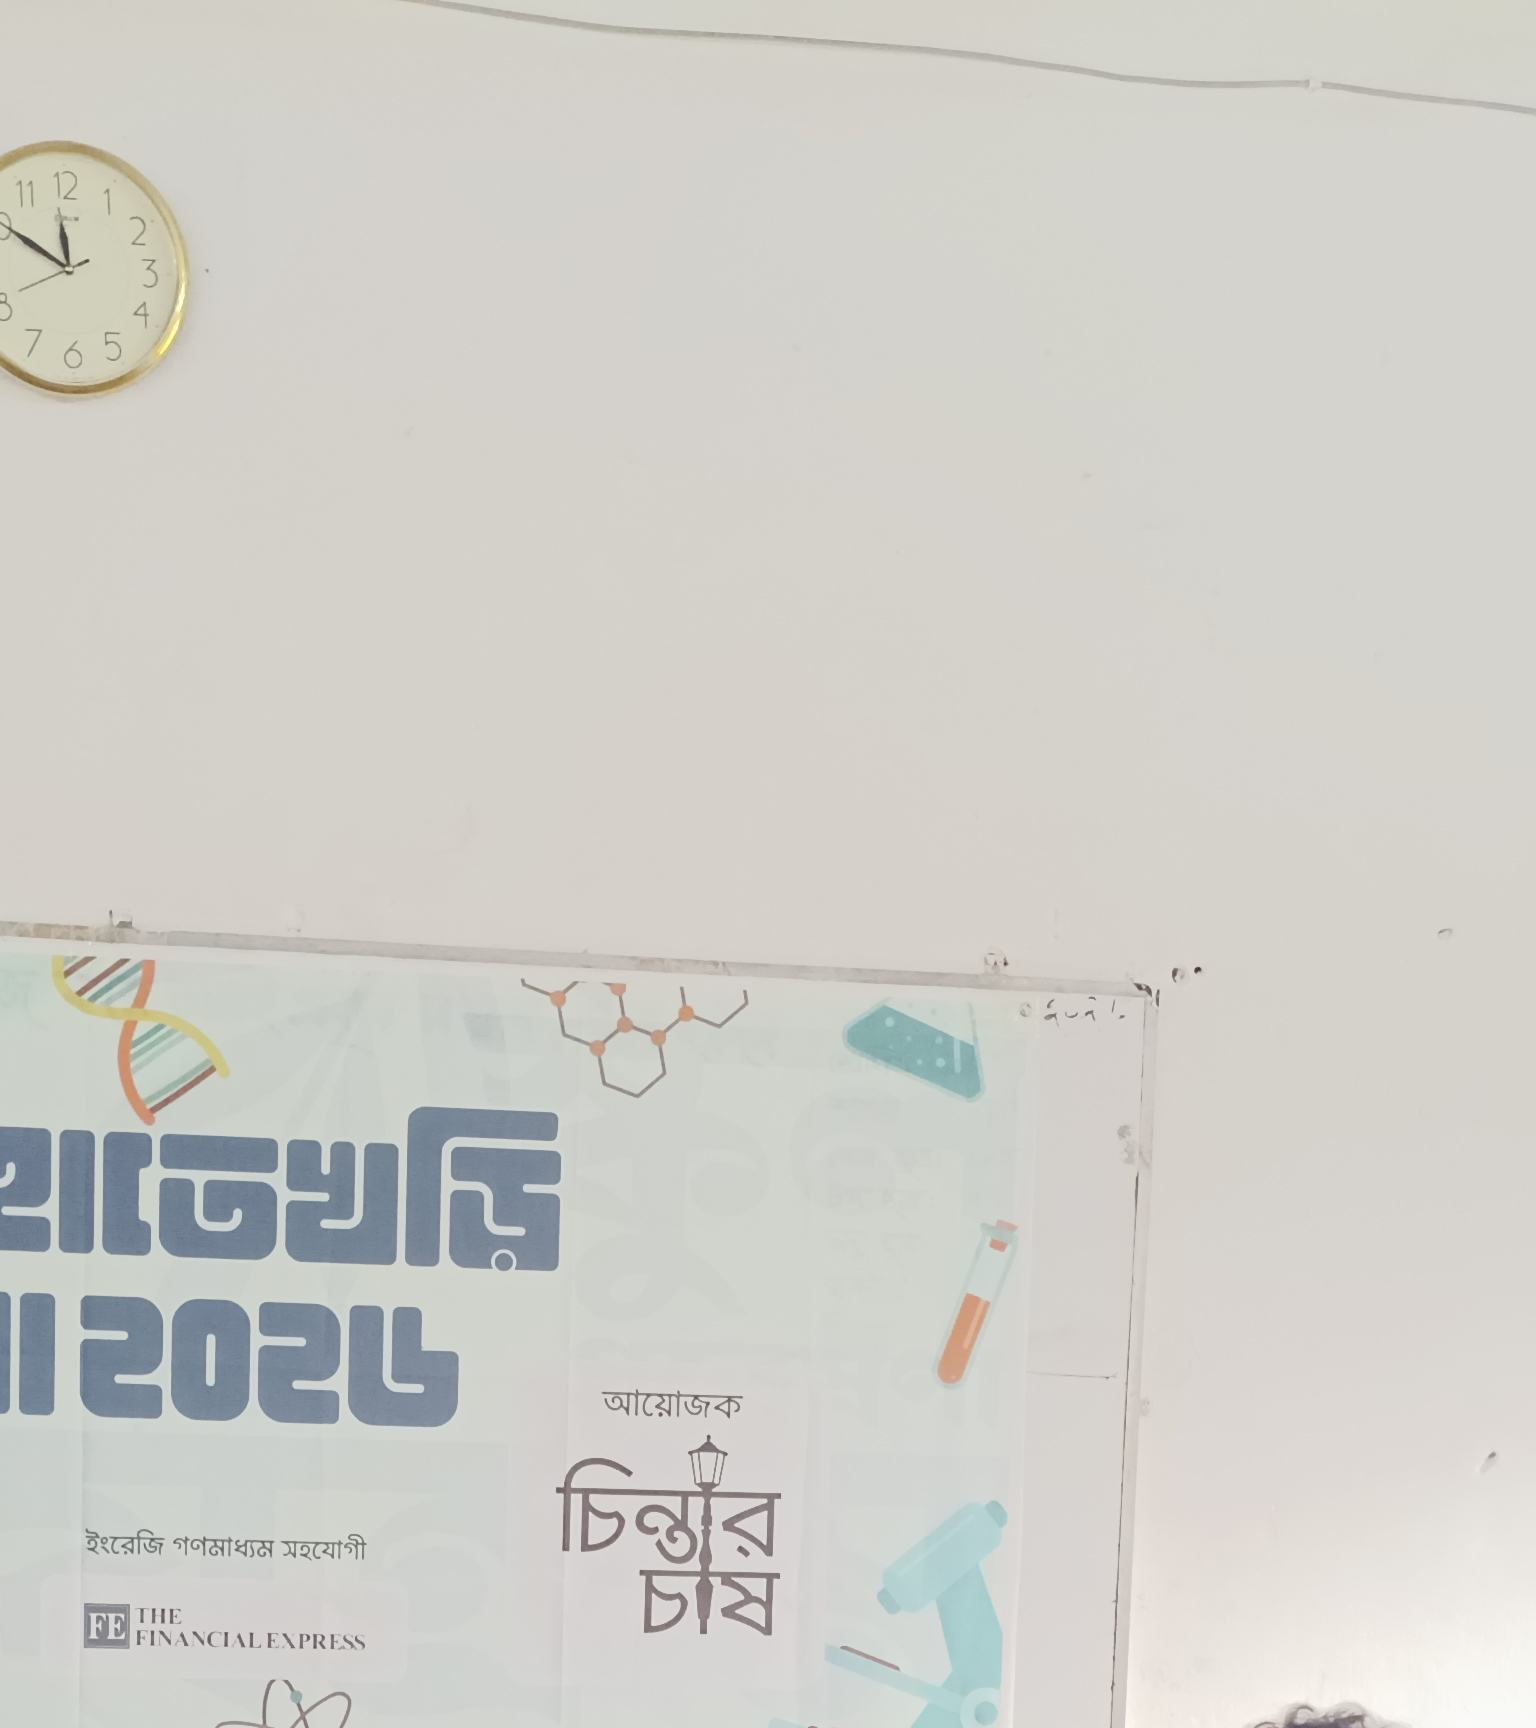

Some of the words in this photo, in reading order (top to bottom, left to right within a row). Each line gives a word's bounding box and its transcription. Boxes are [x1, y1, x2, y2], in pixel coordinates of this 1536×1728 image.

[15, 180, 35, 208] 11
[52, 170, 78, 201] 12
[103, 188, 111, 215] 1
[129, 215, 147, 246] 2
[141, 258, 159, 288] 3
[133, 301, 149, 328] 4
[24, 327, 43, 357] 7
[64, 340, 82, 368] 6
[104, 331, 122, 361] 5
[79, 1294, 459, 1428] ২০২৬
[601, 1389, 743, 1418] আয়োজক
[556, 1457, 781, 1564] চিন্তার
[85, 1528, 165, 1555] ইংরেজি
[173, 1535, 274, 1558] গণমাধ্যম
[281, 1533, 367, 1561] সহযোগী
[135, 1607, 182, 1625] THE
[639, 1570, 780, 1636] চাষ
[87, 1612, 126, 1640] FE
[135, 1629, 262, 1650] FINANCIAL
[266, 1632, 366, 1651] EXPRESS
